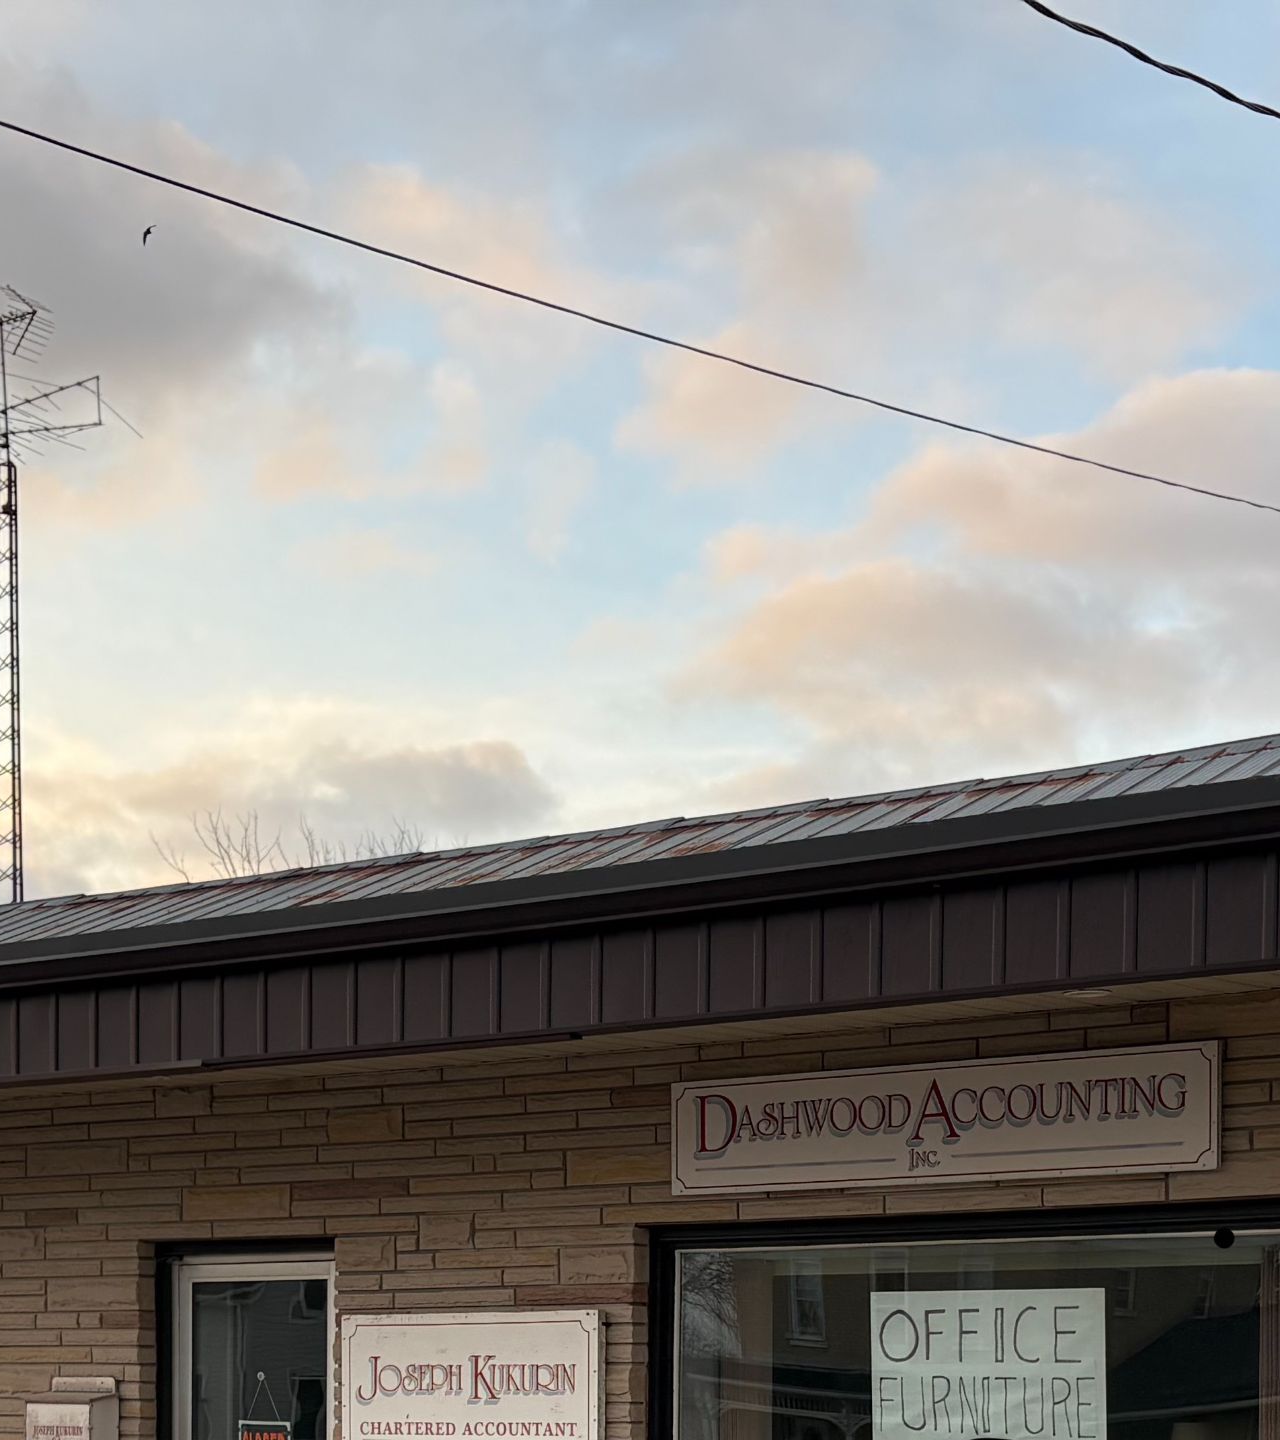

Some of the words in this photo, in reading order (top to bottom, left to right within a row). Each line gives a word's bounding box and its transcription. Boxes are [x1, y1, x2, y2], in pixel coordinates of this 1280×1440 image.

[693, 1093, 911, 1159] DASHWOOD
[906, 1073, 1187, 1147] ACCOUNTING
[879, 1306, 1082, 1363] OFFICE
[356, 1356, 463, 1405] JOSEPH
[467, 1355, 577, 1405] KUKURIN
[879, 1375, 1096, 1438] FURNITURE
[359, 1421, 456, 1437] CHARTERED
[462, 1422, 577, 1437] ACCOUNTANT
